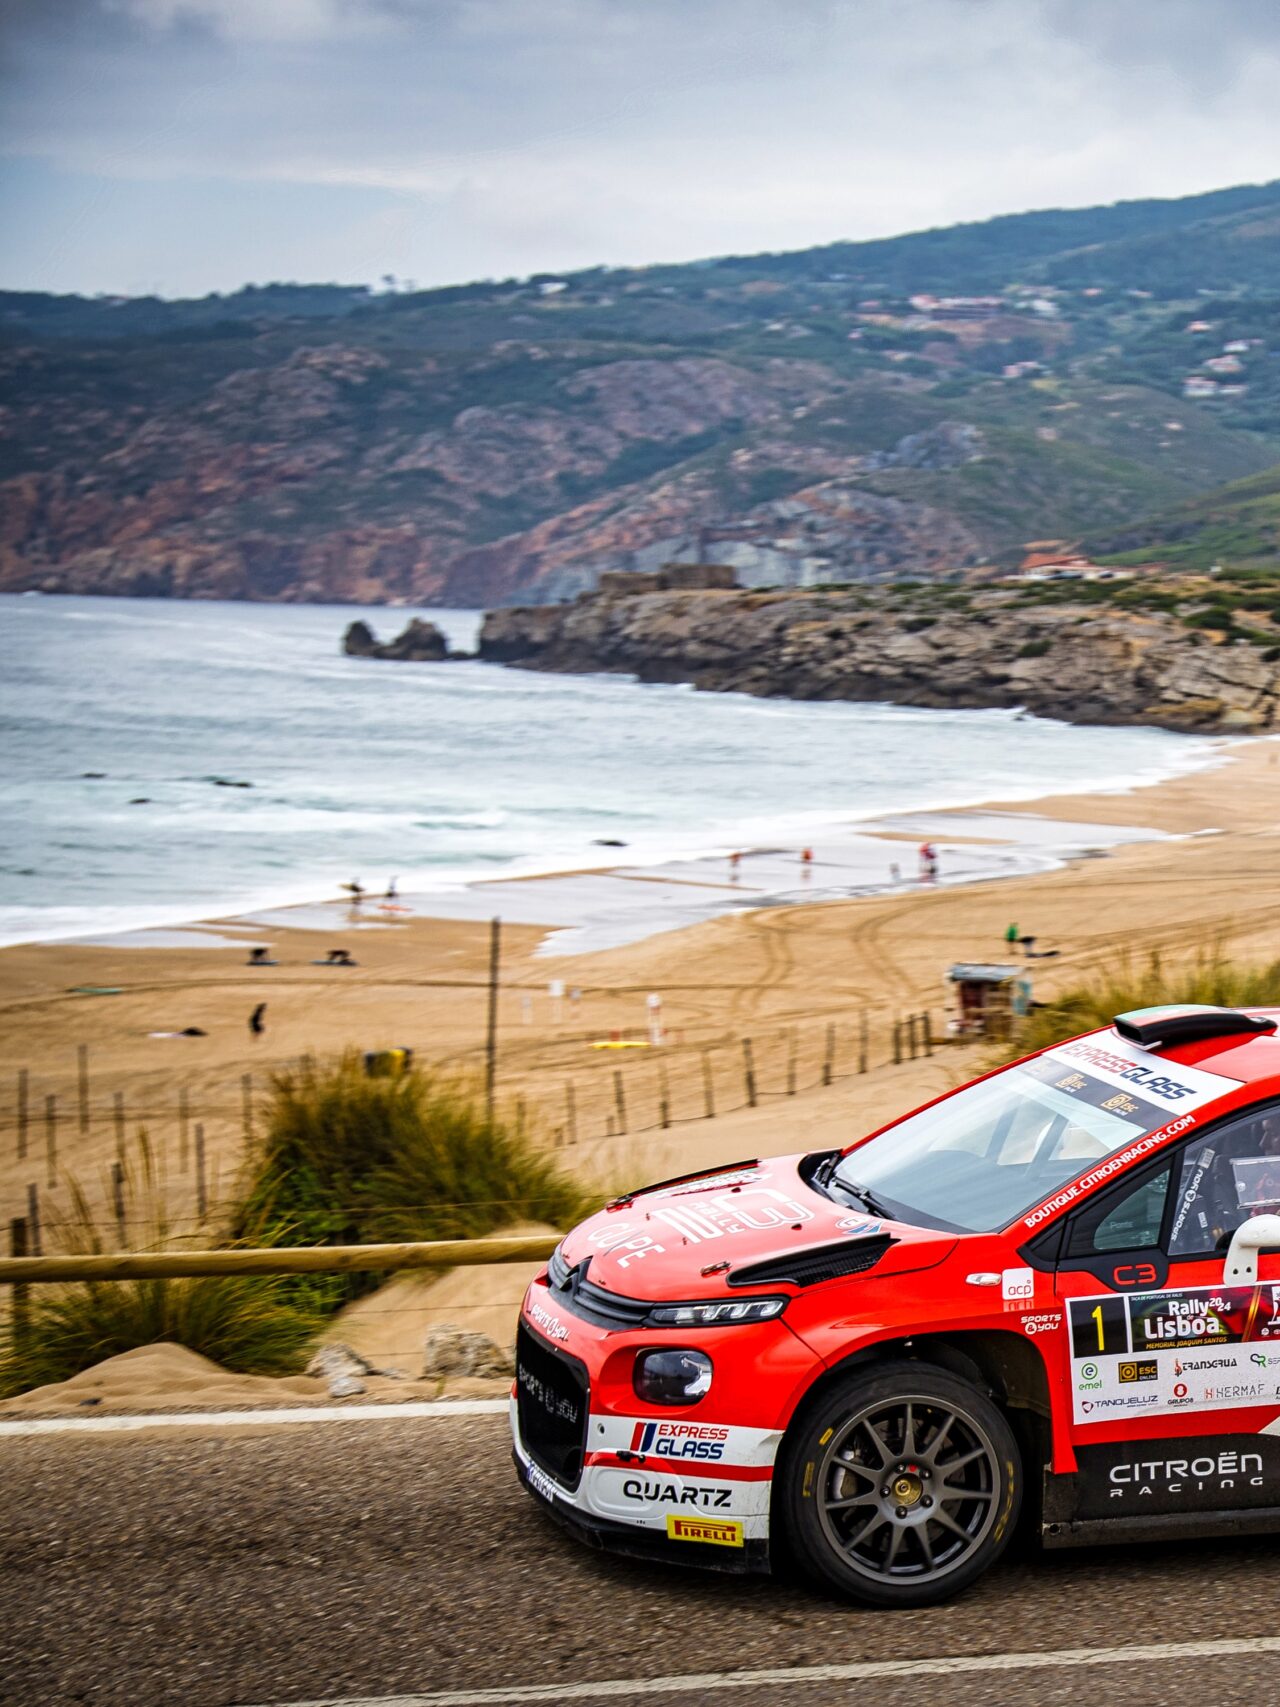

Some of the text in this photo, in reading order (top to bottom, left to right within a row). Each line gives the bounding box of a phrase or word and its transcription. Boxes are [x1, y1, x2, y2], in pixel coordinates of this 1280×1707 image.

[1024, 1115, 1196, 1229] BOUTIQUE.CITROENRACING.COM
[1113, 1264, 1157, 1285] C3
[1008, 1284, 1032, 1296] acp
[1168, 1298, 1209, 1317] Rally
[1020, 1313, 1062, 1324] SPORTS
[1091, 1305, 1105, 1351] 1
[1144, 1315, 1221, 1340] Lisboa
[1146, 1341, 1176, 1350] MEMORIAL
[1203, 1336, 1228, 1344] SANTOS
[1139, 1366, 1157, 1375] ESC
[1079, 1380, 1103, 1391] emel
[1216, 1384, 1265, 1398] HERMAF
[1095, 1395, 1158, 1407] TANQUELUZ
[658, 1424, 730, 1440] EXPRESS
[655, 1438, 725, 1460] GLASS
[623, 1480, 733, 1507] QUARTZ
[1110, 1477, 1263, 1498] RACING
[673, 1520, 737, 1542] PIRELLI
